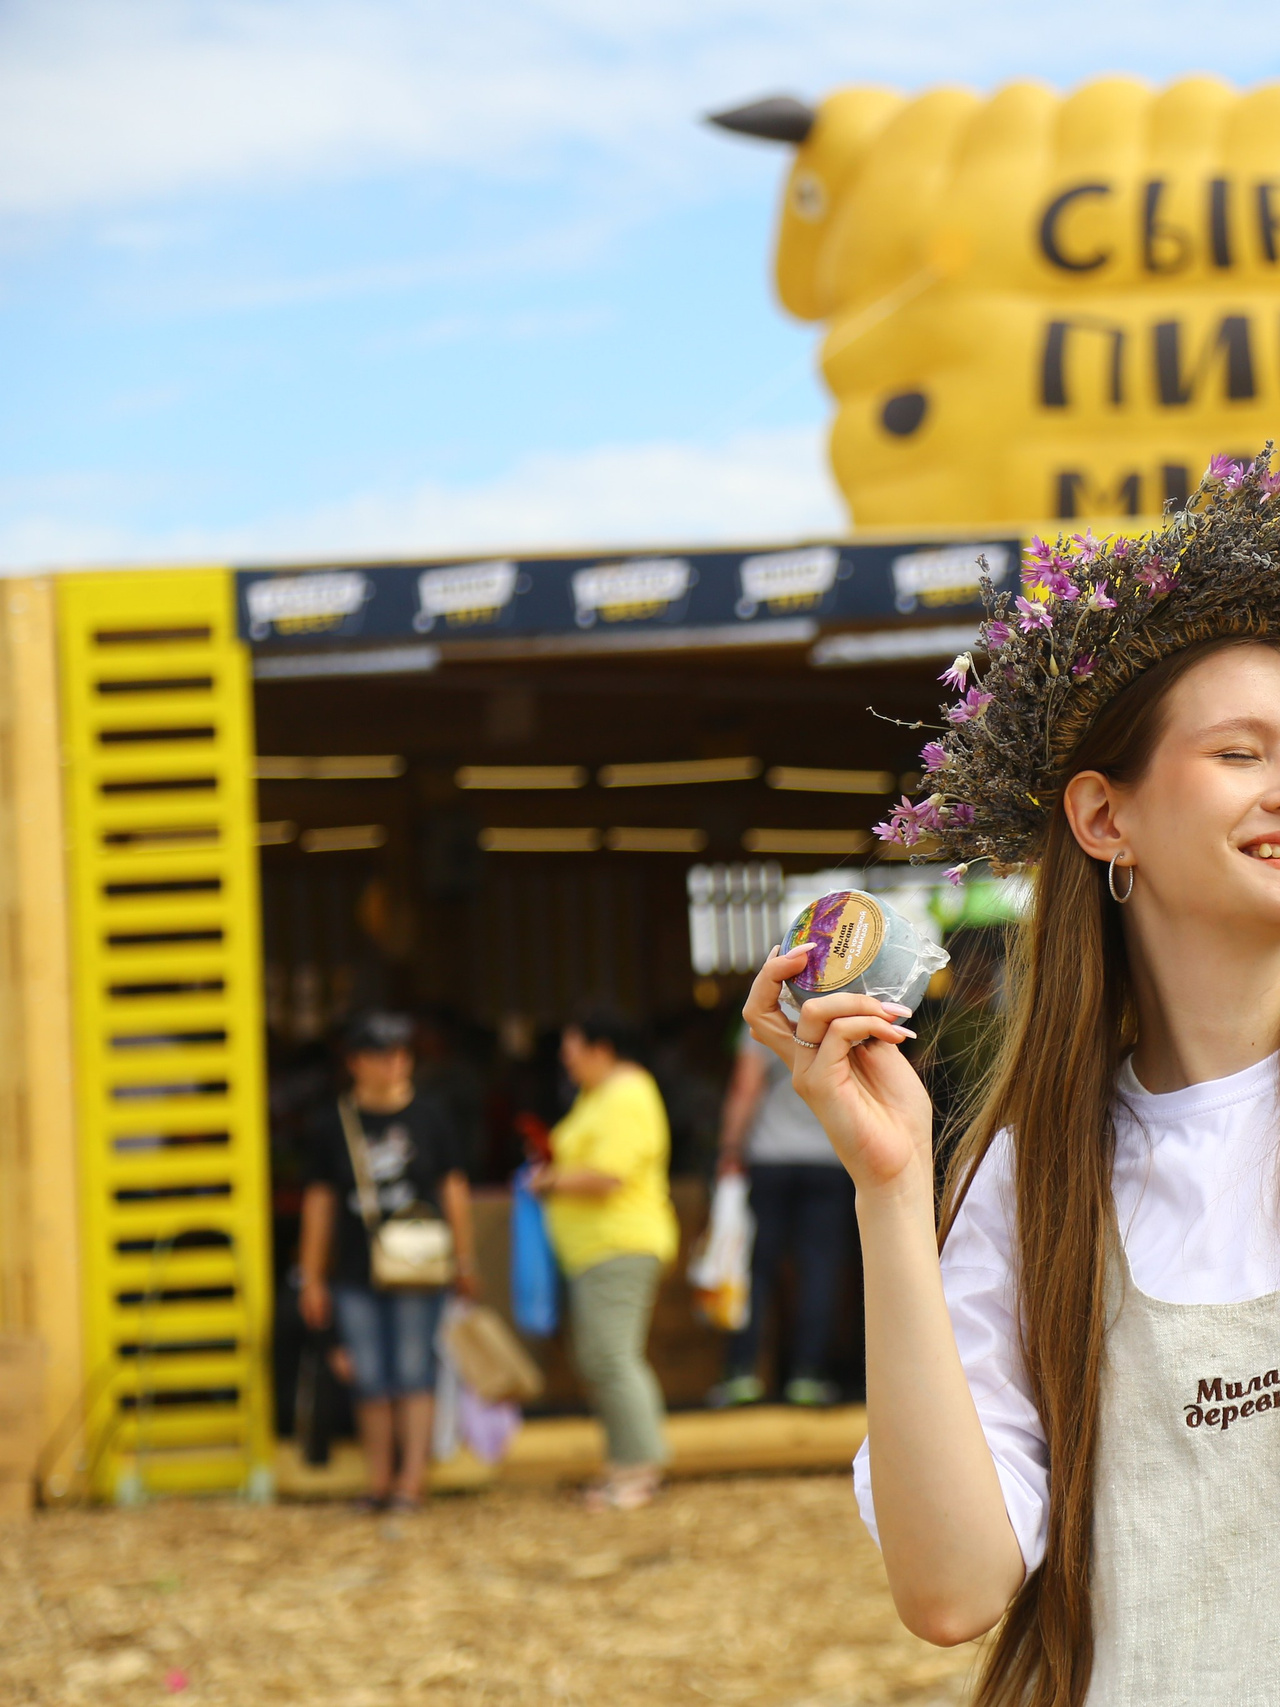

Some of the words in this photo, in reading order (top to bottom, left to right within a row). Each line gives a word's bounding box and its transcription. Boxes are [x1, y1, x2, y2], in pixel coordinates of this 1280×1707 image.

[833, 924, 847, 955] Милая
[838, 922, 855, 958] деревня
[855, 923, 868, 957] ЛАВАНДОЙ
[844, 955, 853, 970] СЫР
